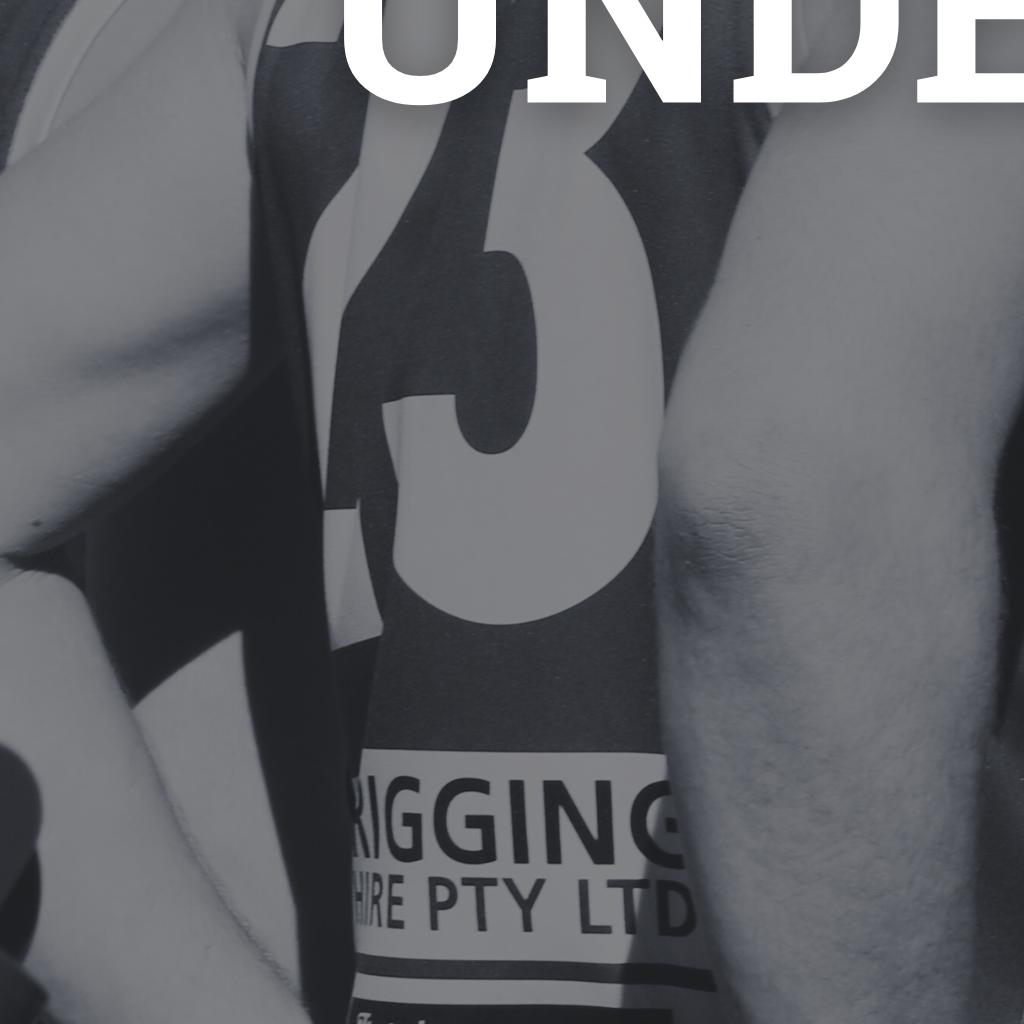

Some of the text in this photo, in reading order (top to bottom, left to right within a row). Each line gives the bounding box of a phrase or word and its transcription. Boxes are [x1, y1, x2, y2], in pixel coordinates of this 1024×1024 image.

[351, 775, 686, 870] RIGGING
[427, 876, 546, 933] PTY
[577, 878, 697, 938] LTD
